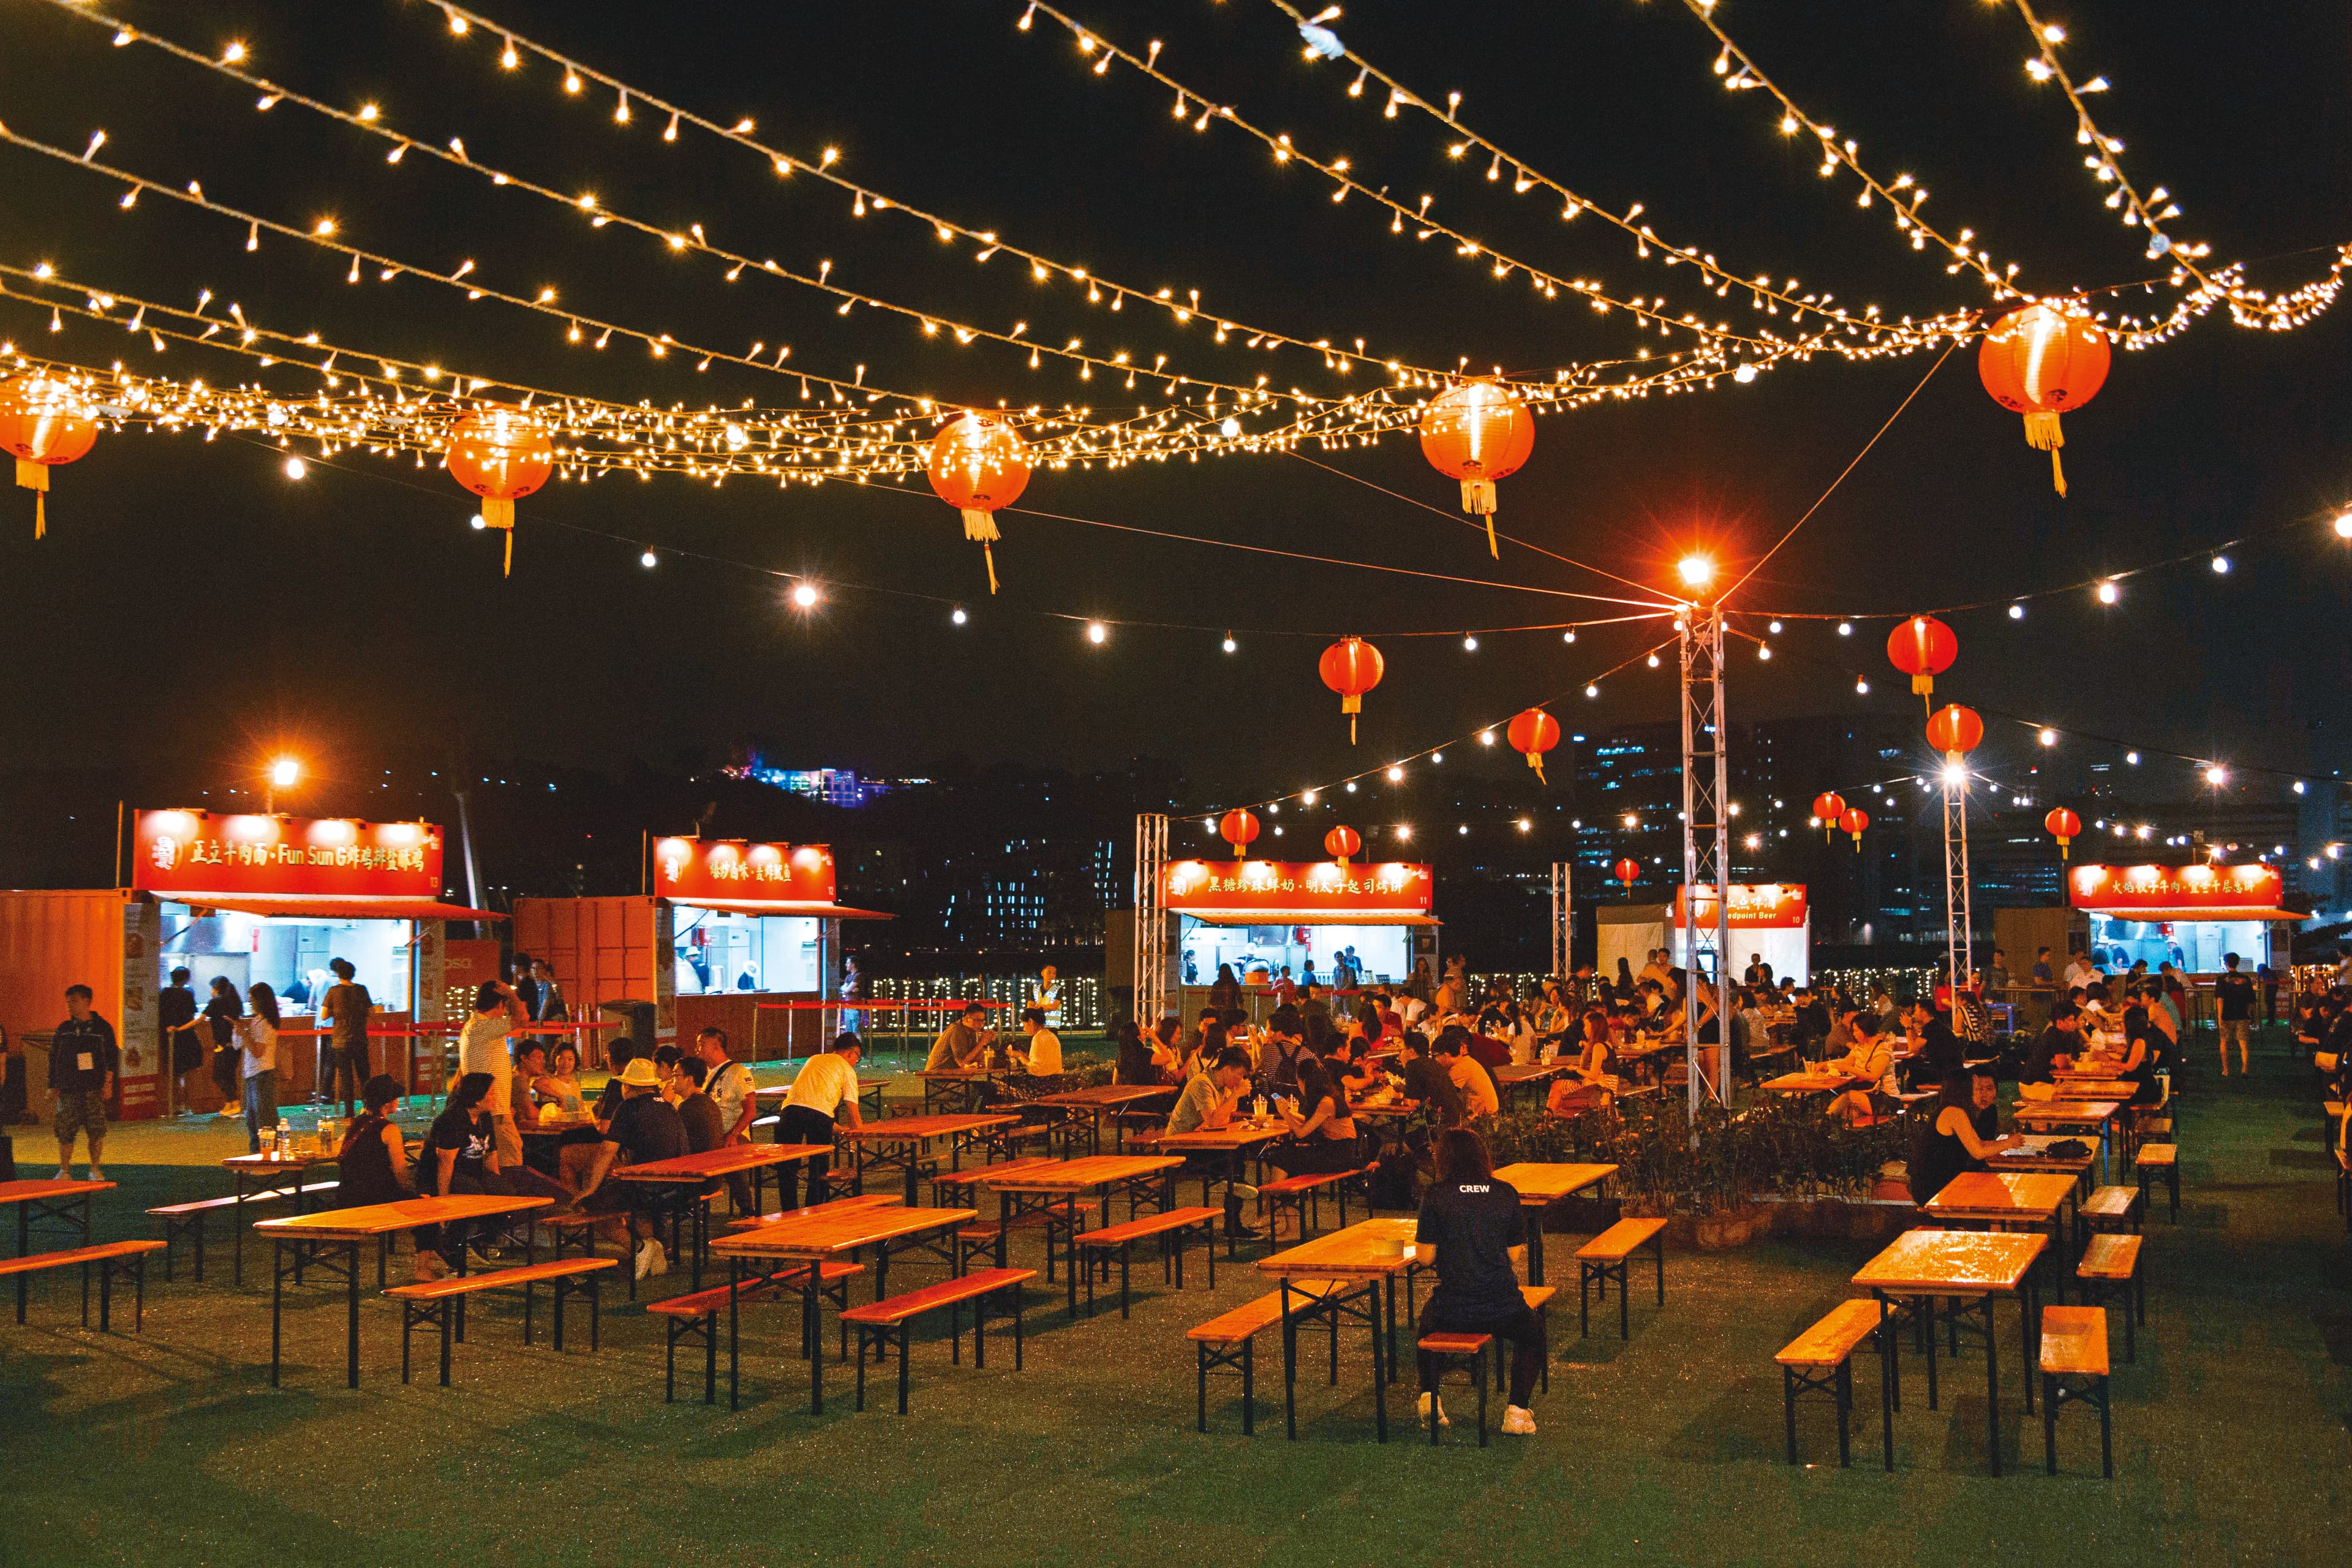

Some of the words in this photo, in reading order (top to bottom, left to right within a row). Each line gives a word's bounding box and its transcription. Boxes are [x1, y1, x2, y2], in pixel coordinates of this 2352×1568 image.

[307, 845, 333, 866] Sun
[429, 876, 439, 888] 13
[828, 886, 834, 895] 12
[1420, 896, 1427, 905] 11
[1459, 1185, 1490, 1193] CREW
